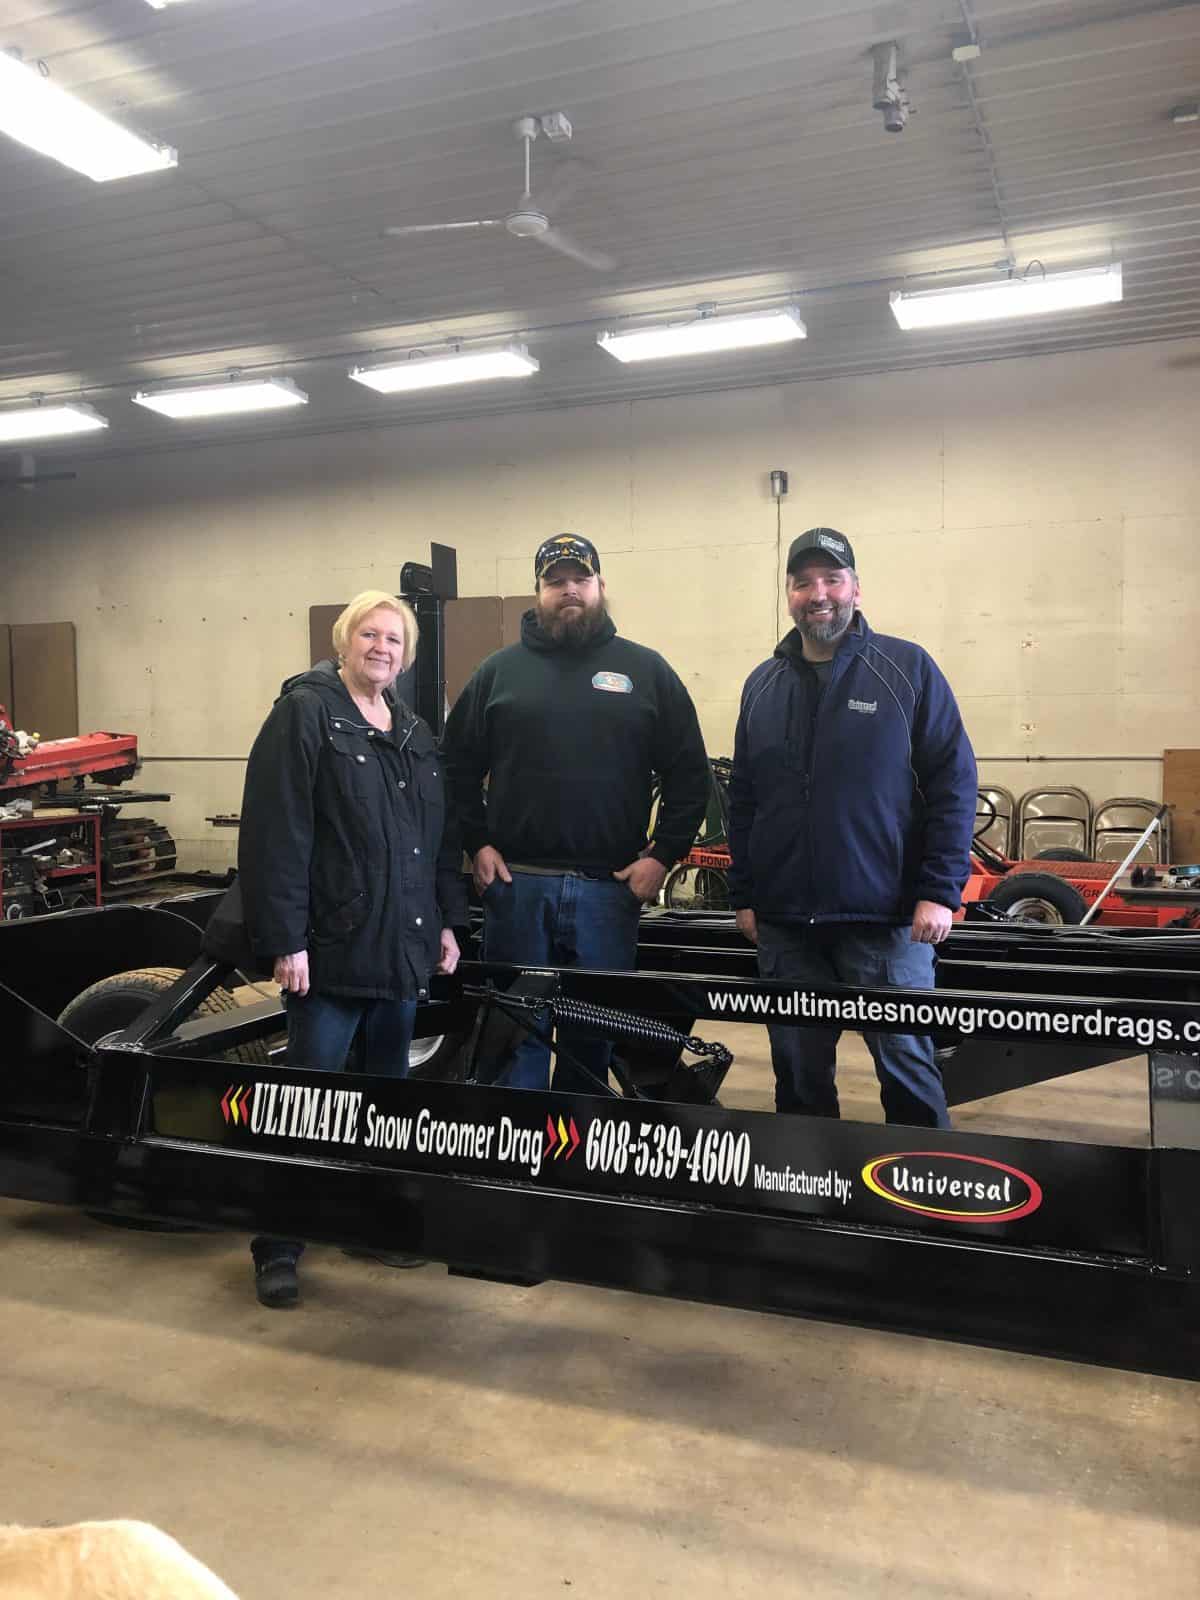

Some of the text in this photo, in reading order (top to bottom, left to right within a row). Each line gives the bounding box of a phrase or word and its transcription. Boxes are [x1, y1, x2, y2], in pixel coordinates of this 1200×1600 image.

[701, 855, 730, 867] POND
[250, 1082, 751, 1187] ULTIMATE Snow Groomer Drag 608-539-4600
[753, 1163, 853, 1205] Manufactured by:
[892, 1166, 1012, 1202] Universal
